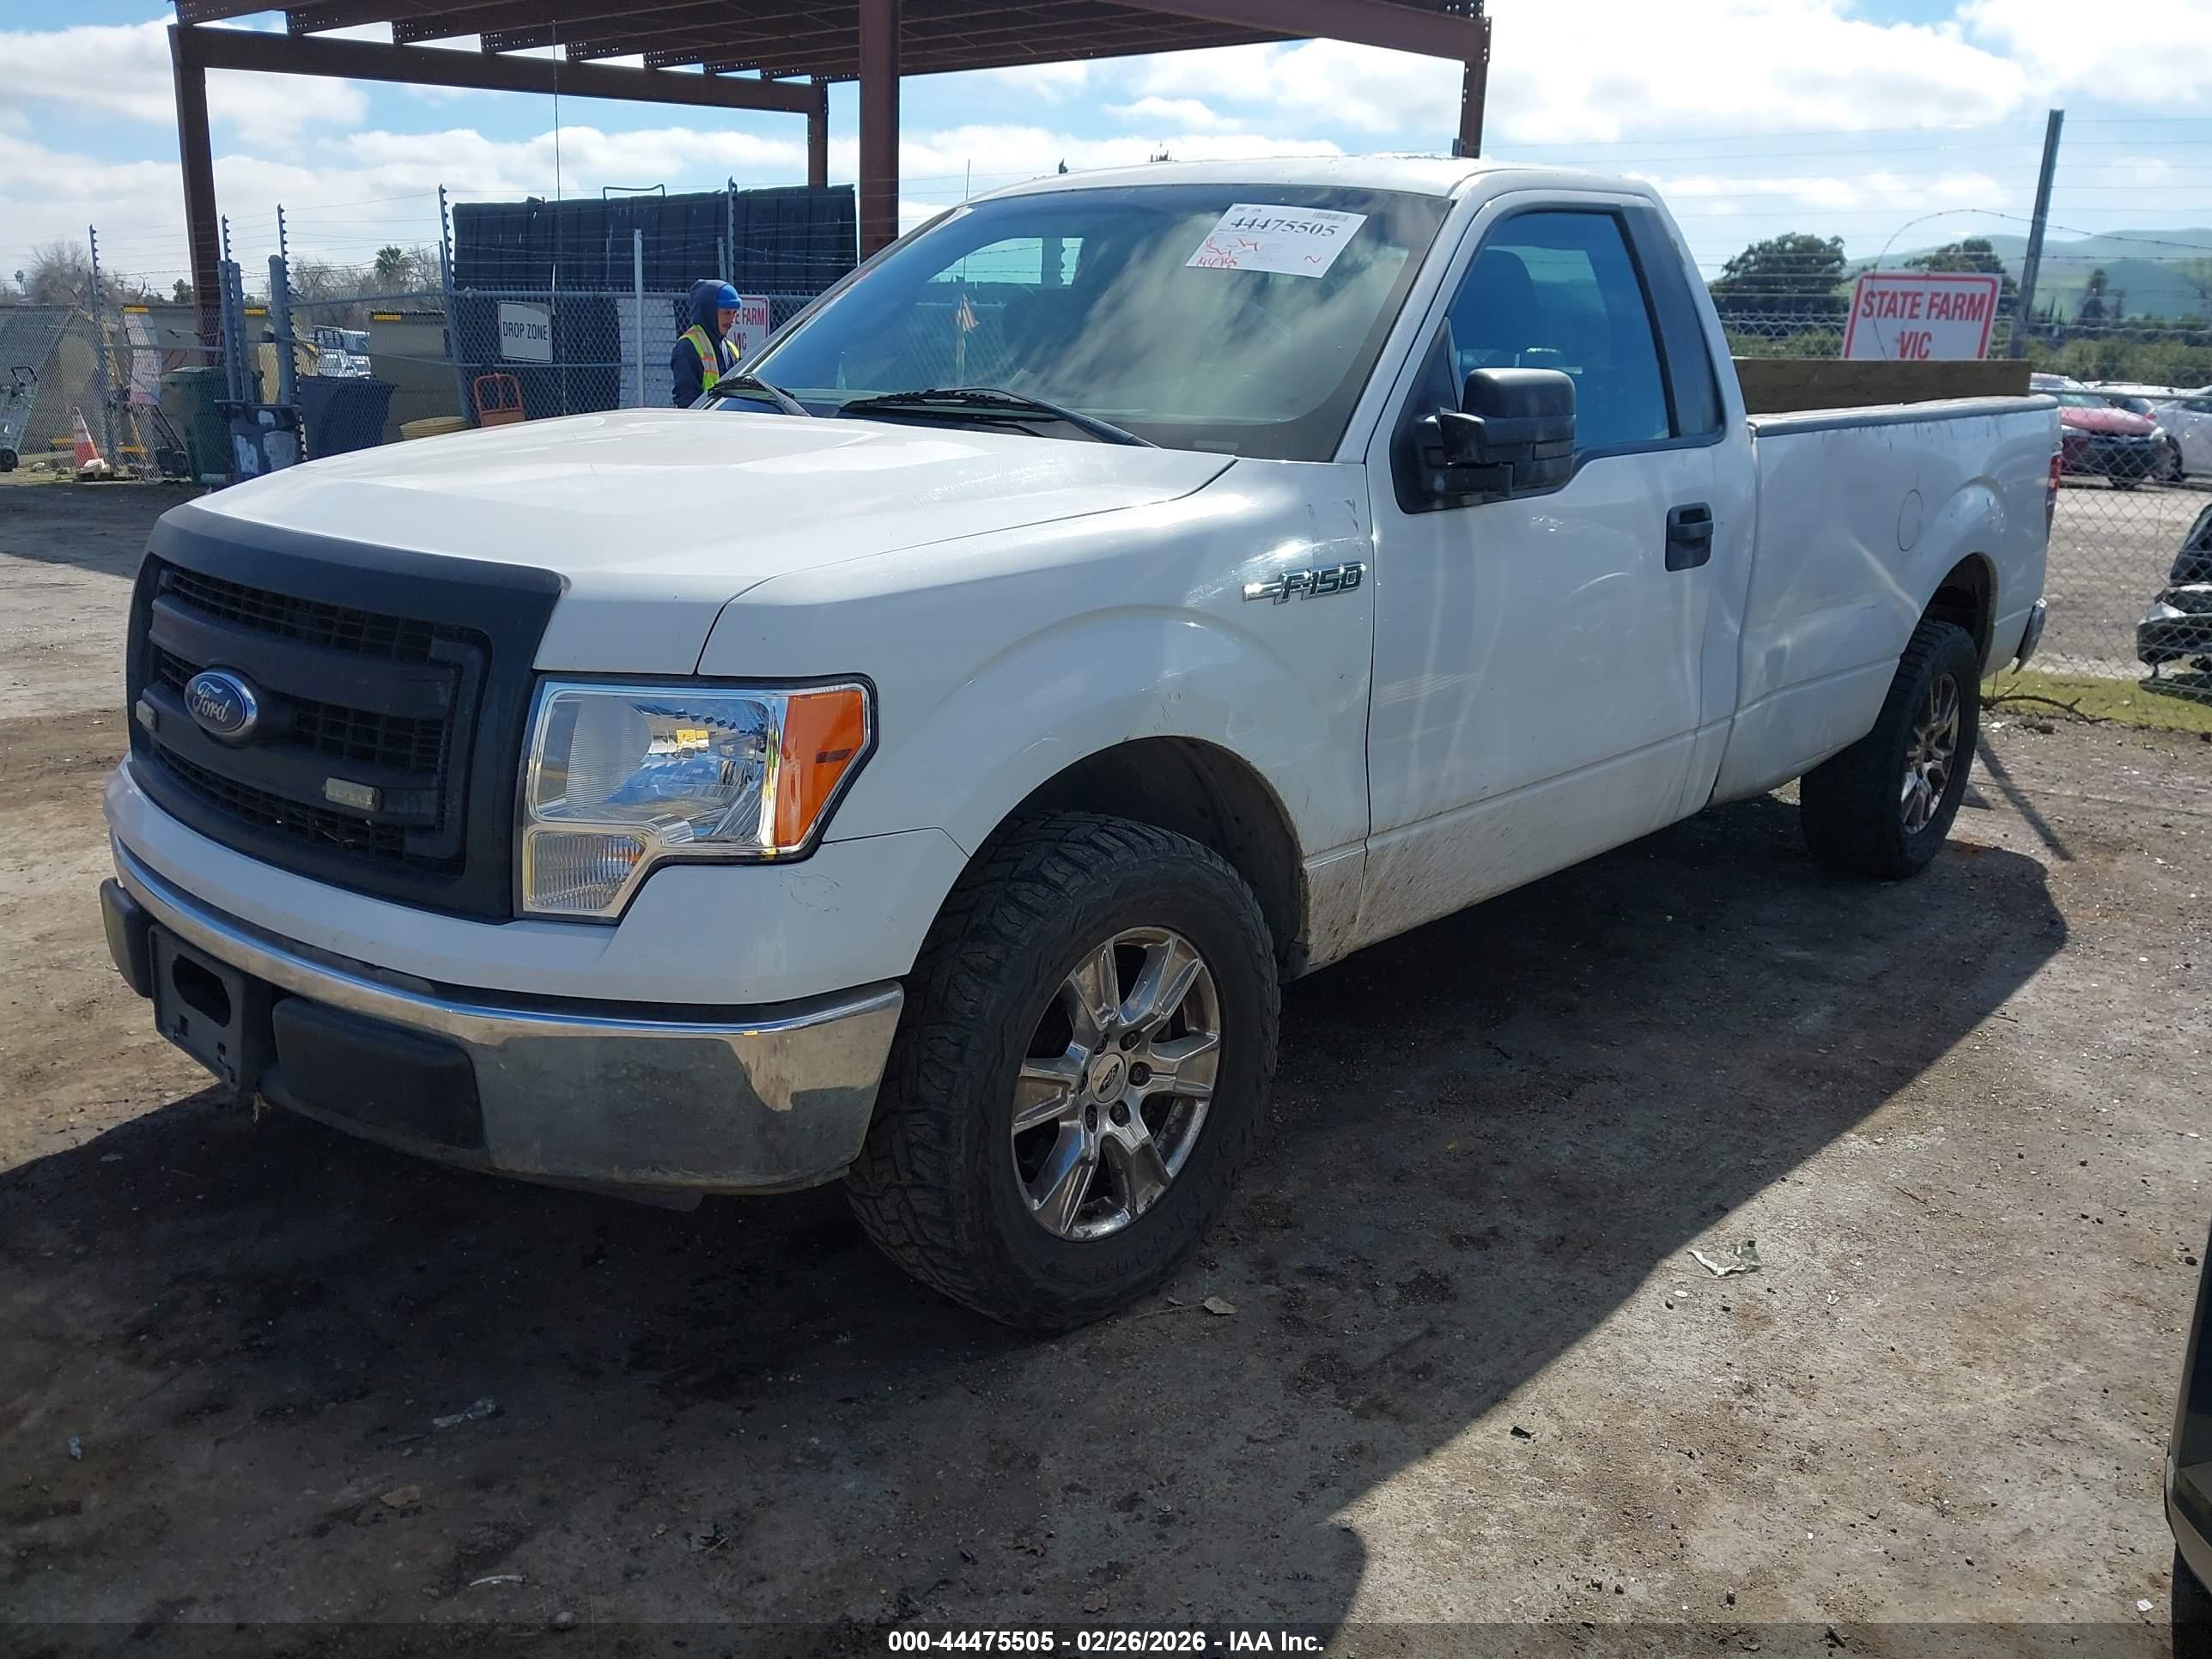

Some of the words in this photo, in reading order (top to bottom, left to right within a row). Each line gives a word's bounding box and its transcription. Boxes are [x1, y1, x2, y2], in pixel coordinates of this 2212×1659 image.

[1230, 216, 1340, 237] 44475505
[742, 307, 765, 325] FARM
[1862, 289, 1923, 319] STATE
[1926, 291, 1987, 322] FARM
[502, 321, 525, 338] DROP
[526, 323, 548, 341] ZONE
[1899, 331, 1932, 360] VIC
[192, 681, 230, 722] Ford
